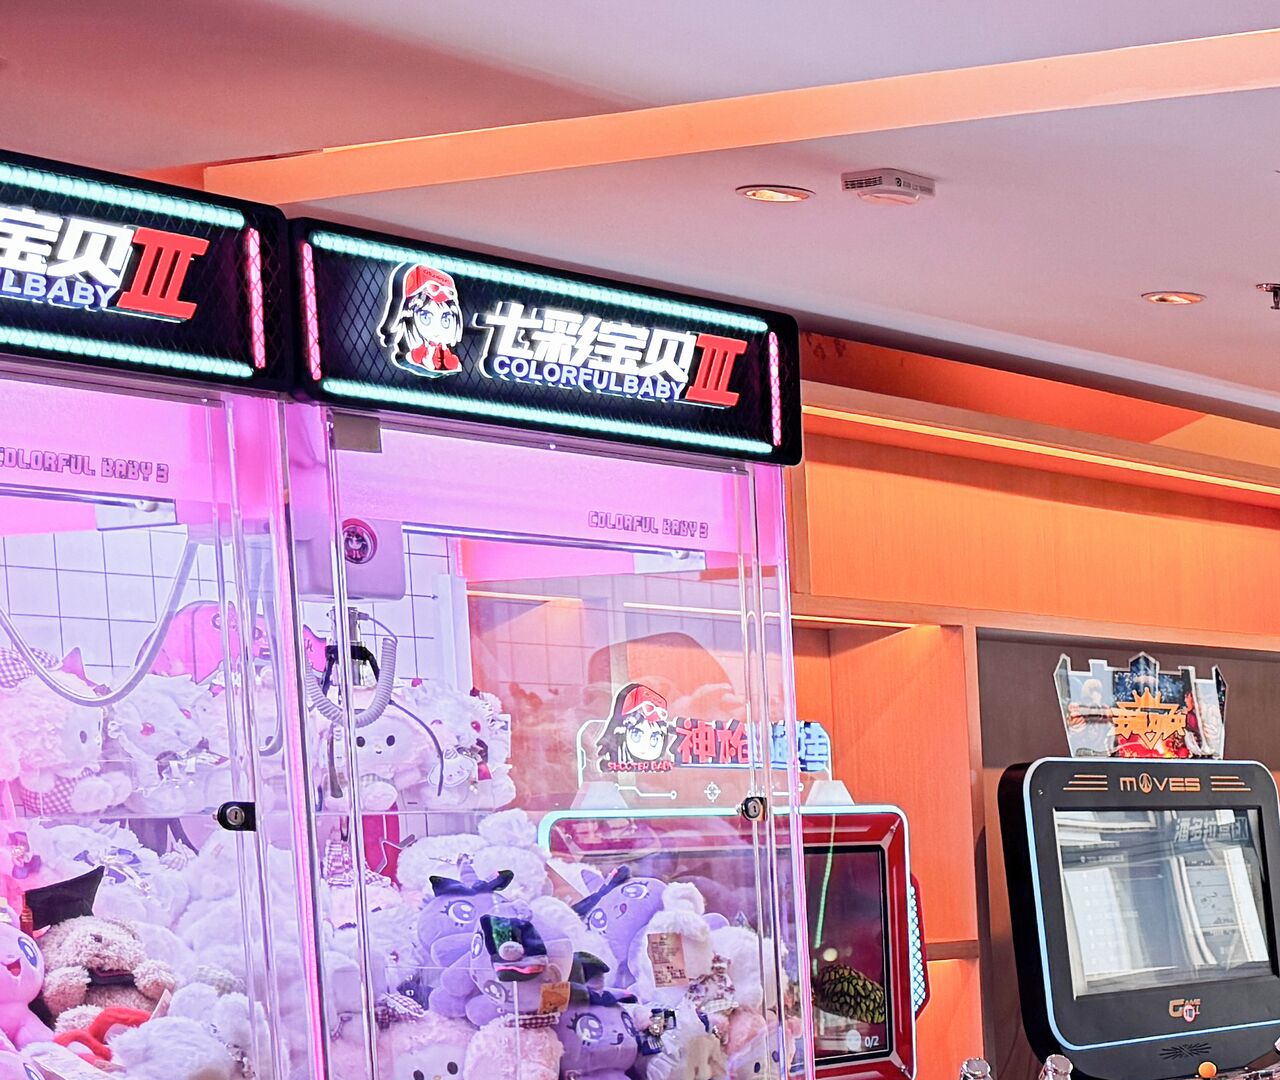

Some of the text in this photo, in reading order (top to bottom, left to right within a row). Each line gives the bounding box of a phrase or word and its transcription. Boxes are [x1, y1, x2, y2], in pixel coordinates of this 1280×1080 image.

[493, 356, 685, 400] COLORFULBABY
[101, 457, 152, 482] BABY
[156, 463, 169, 483] 3
[588, 511, 659, 535] COLORFUL
[662, 518, 697, 538] BABY
